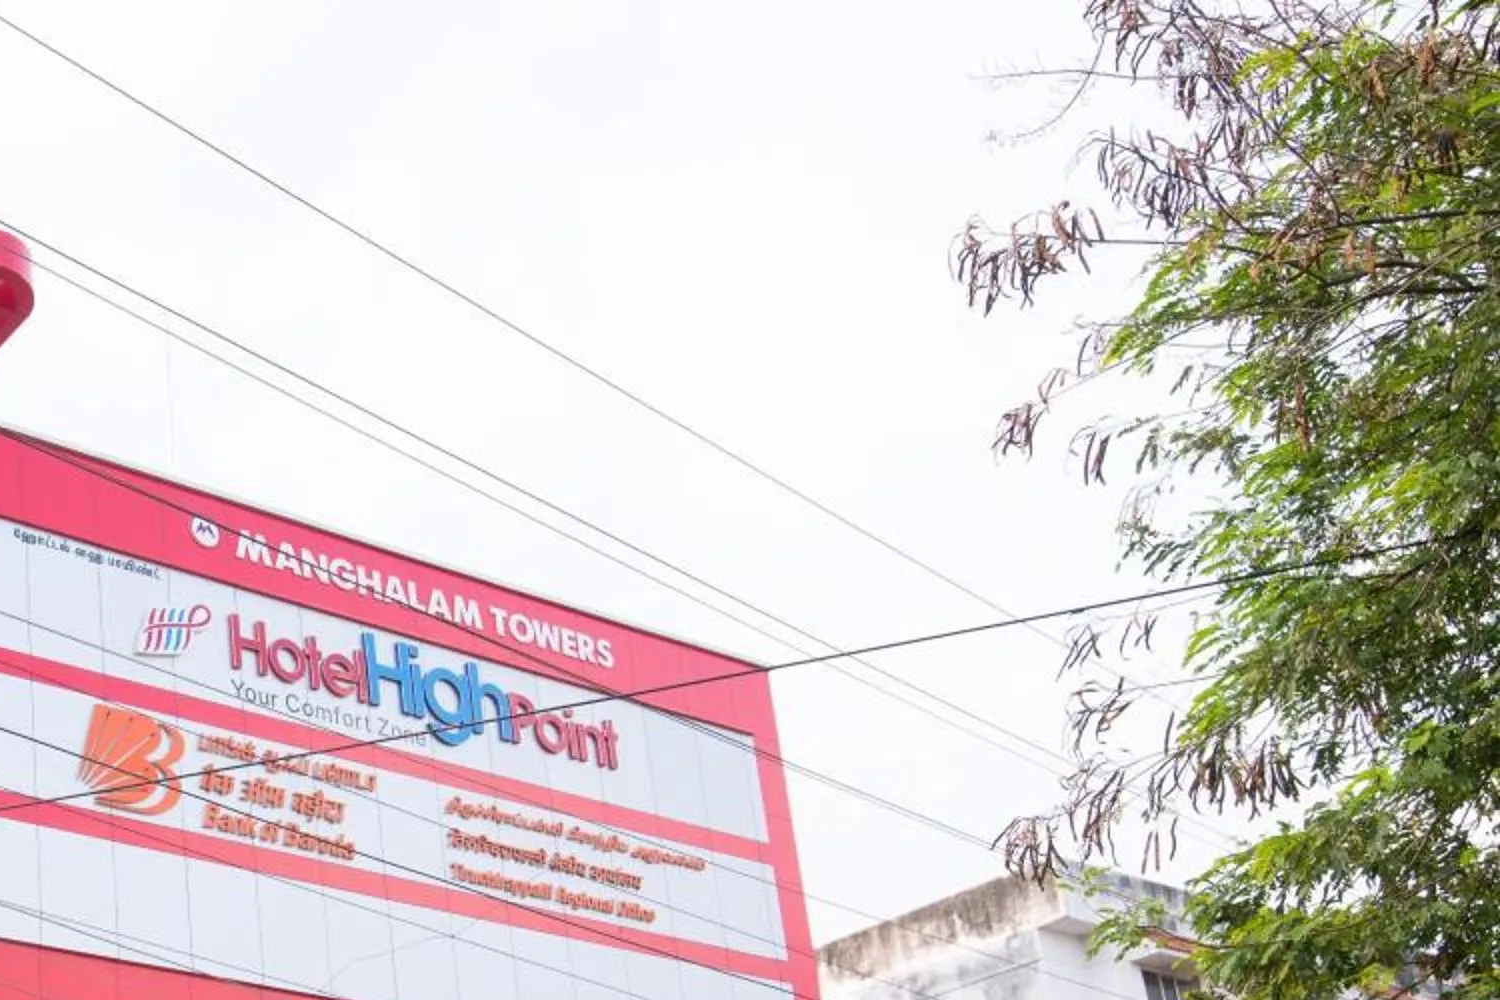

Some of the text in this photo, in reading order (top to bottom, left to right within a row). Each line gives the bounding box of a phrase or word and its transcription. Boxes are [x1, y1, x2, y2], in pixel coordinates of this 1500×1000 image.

[235, 529, 615, 668] MANGHALAM TOWERS
[230, 679, 278, 713] Your
[284, 697, 372, 732] Comfort
